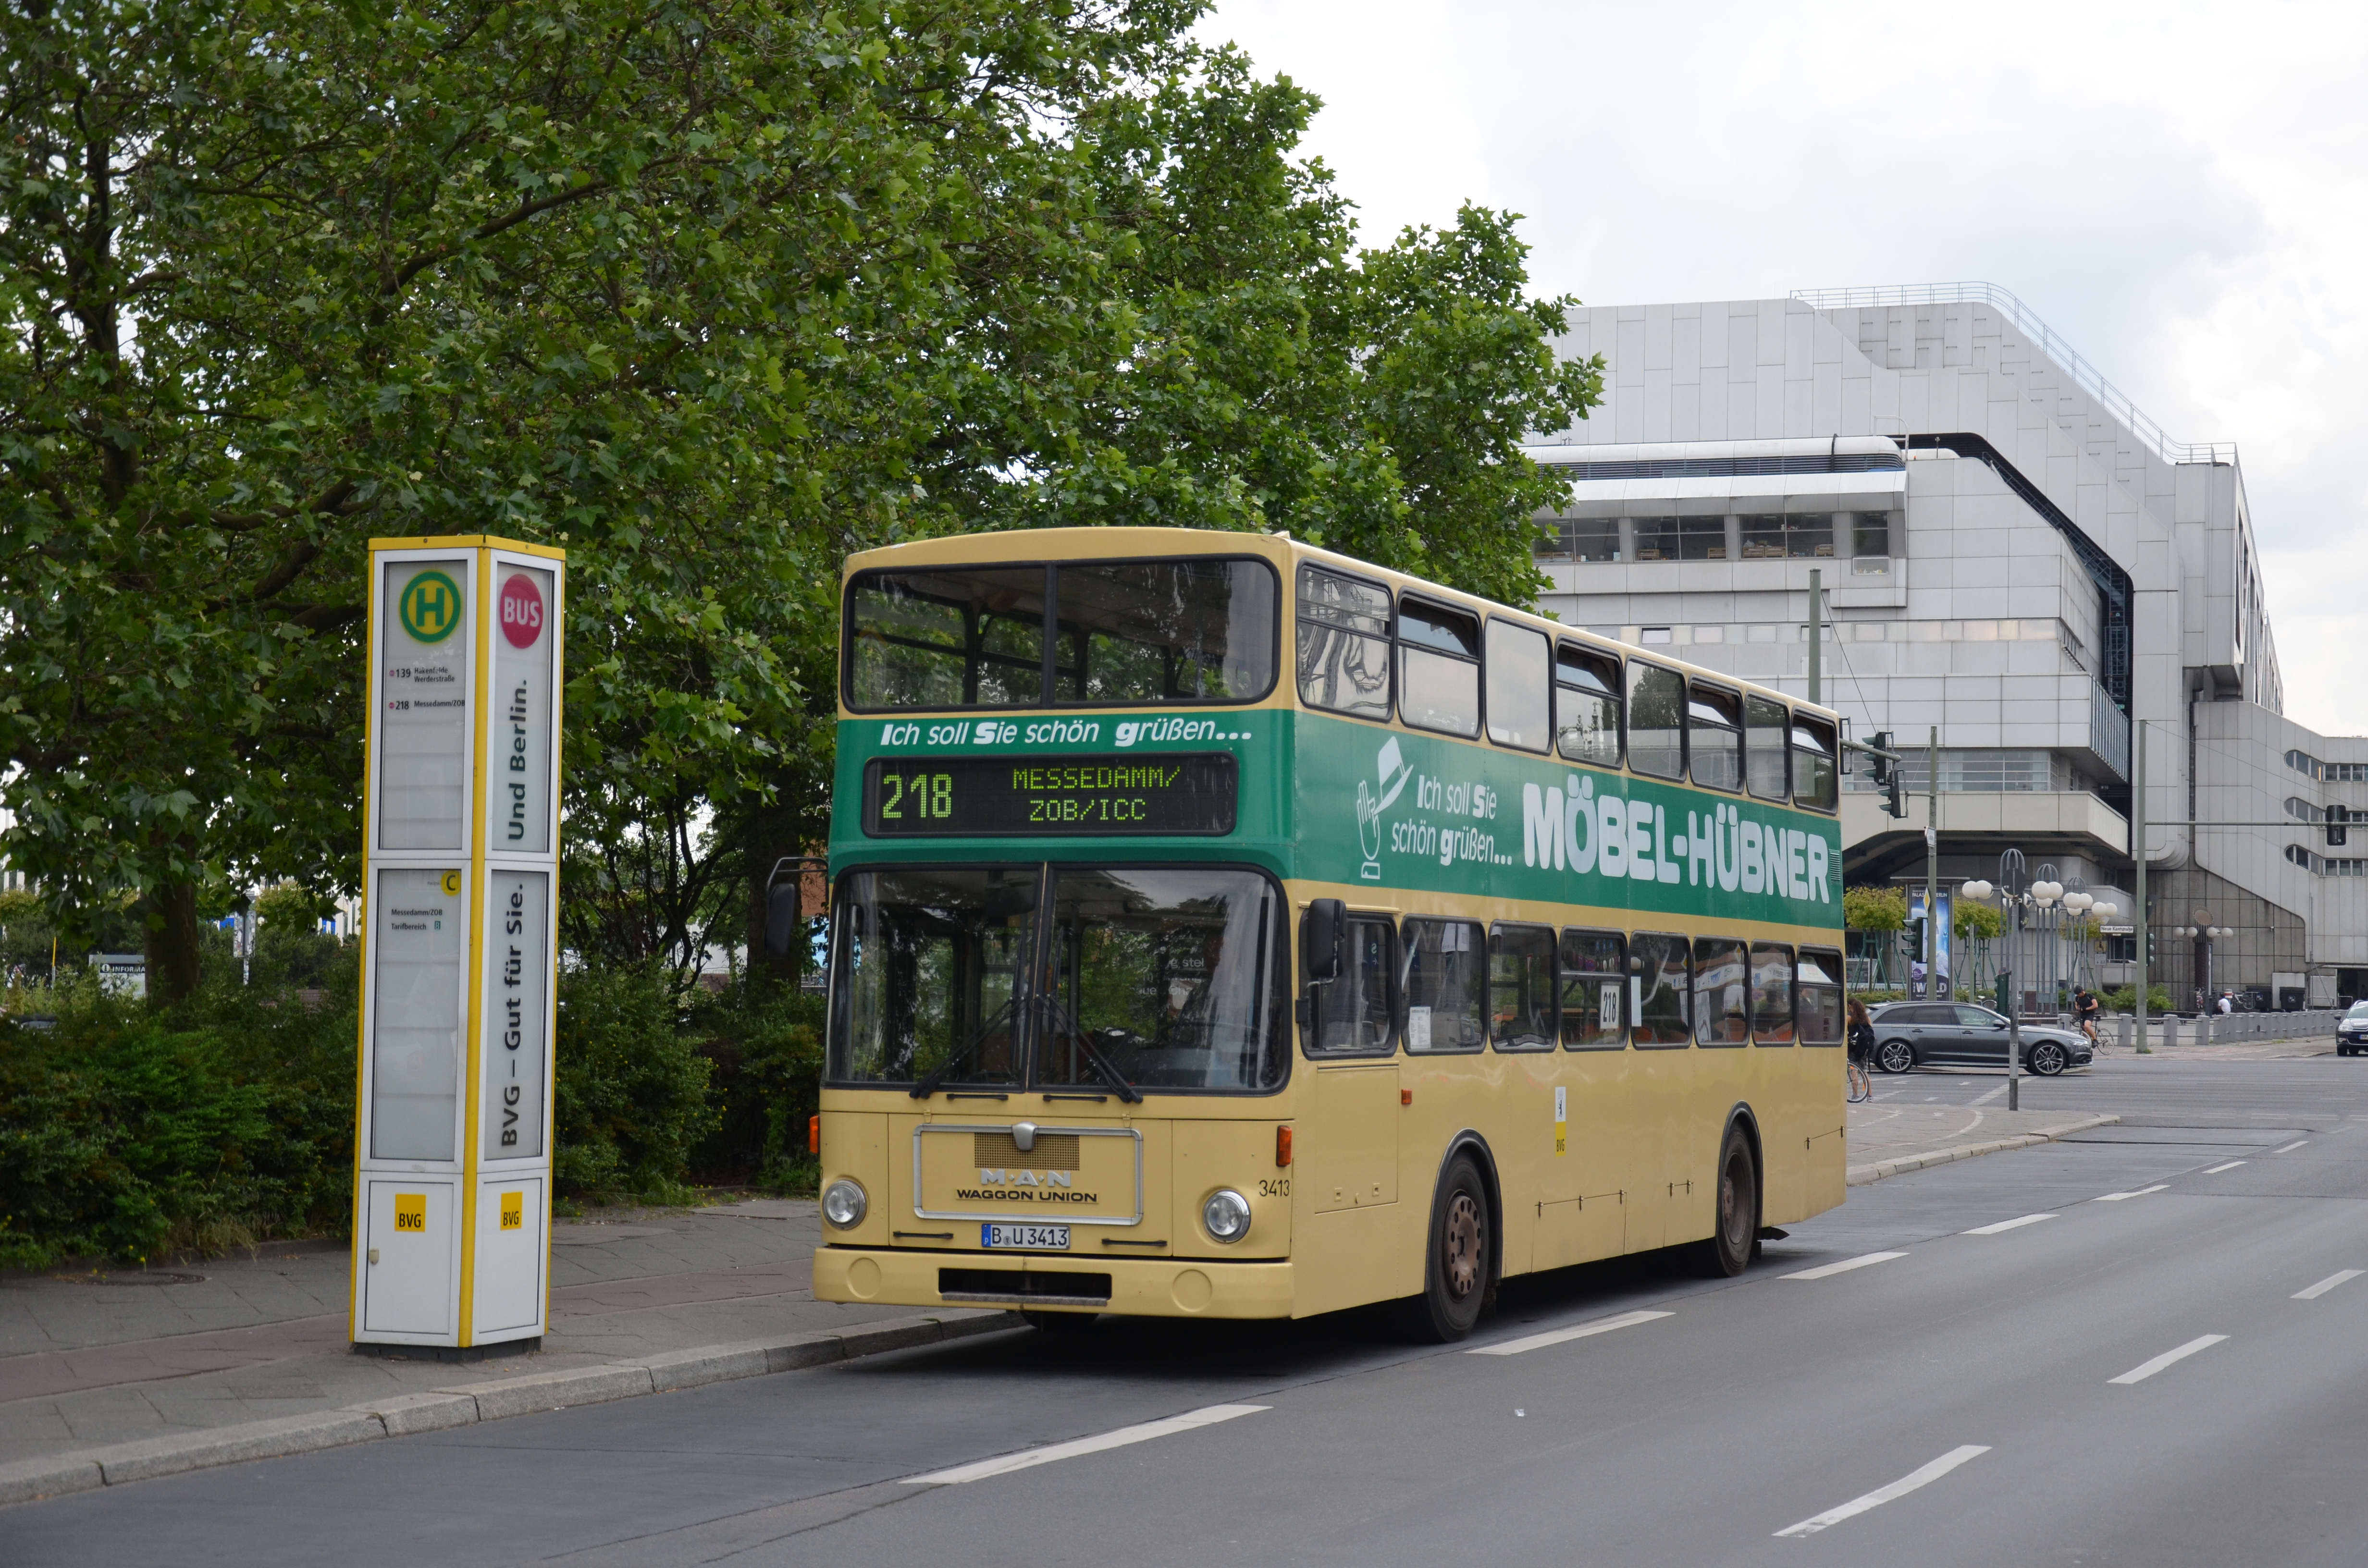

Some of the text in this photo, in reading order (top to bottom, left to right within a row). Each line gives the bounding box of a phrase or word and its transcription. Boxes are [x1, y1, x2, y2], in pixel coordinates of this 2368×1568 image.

[416, 588, 445, 626] H
[504, 596, 540, 627] BUS
[396, 669, 411, 678] 139
[395, 701, 409, 710] 218
[880, 717, 1252, 747] Ich soll Sie schön grüßen...
[508, 680, 527, 840] Und Berlin.
[882, 766, 1181, 819] 218 MESSEDAMM/
[1417, 774, 1496, 820] Ich soll Sie
[1029, 798, 1146, 821] ZOB/ICC
[1391, 819, 1513, 866] schön grüßen...
[1523, 774, 1830, 904] MÖBEL-HÜBNER
[506, 884, 523, 935] Sie.
[505, 945, 521, 988] für
[1603, 992, 1616, 1022] 218
[505, 998, 521, 1051] Gut
[502, 1086, 520, 1146] BVG
[1556, 1139, 1565, 1152] BVG
[957, 1189, 1098, 1202] WAGGON UNION
[1259, 1179, 1290, 1197] 3413
[398, 1213, 421, 1228] BVG
[503, 1211, 519, 1226] BVG
[992, 1227, 1002, 1244] B
[1013, 1228, 1023, 1245] U
[1027, 1228, 1068, 1246] 3413
